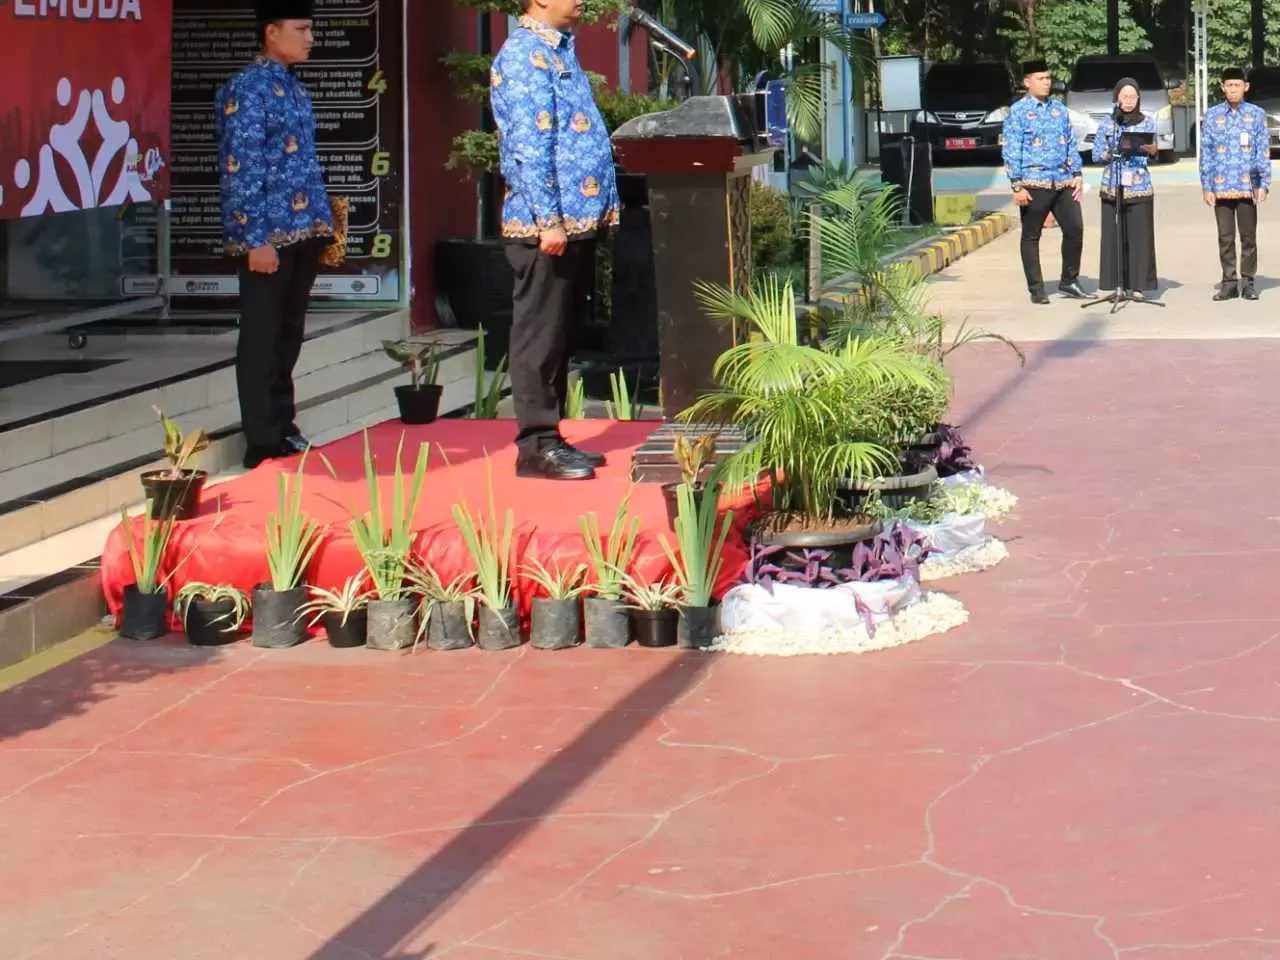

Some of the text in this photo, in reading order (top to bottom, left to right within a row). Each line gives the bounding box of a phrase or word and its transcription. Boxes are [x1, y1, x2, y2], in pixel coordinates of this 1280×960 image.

[367, 70, 388, 95] 4
[371, 151, 391, 176] 6
[371, 233, 392, 258] 8
